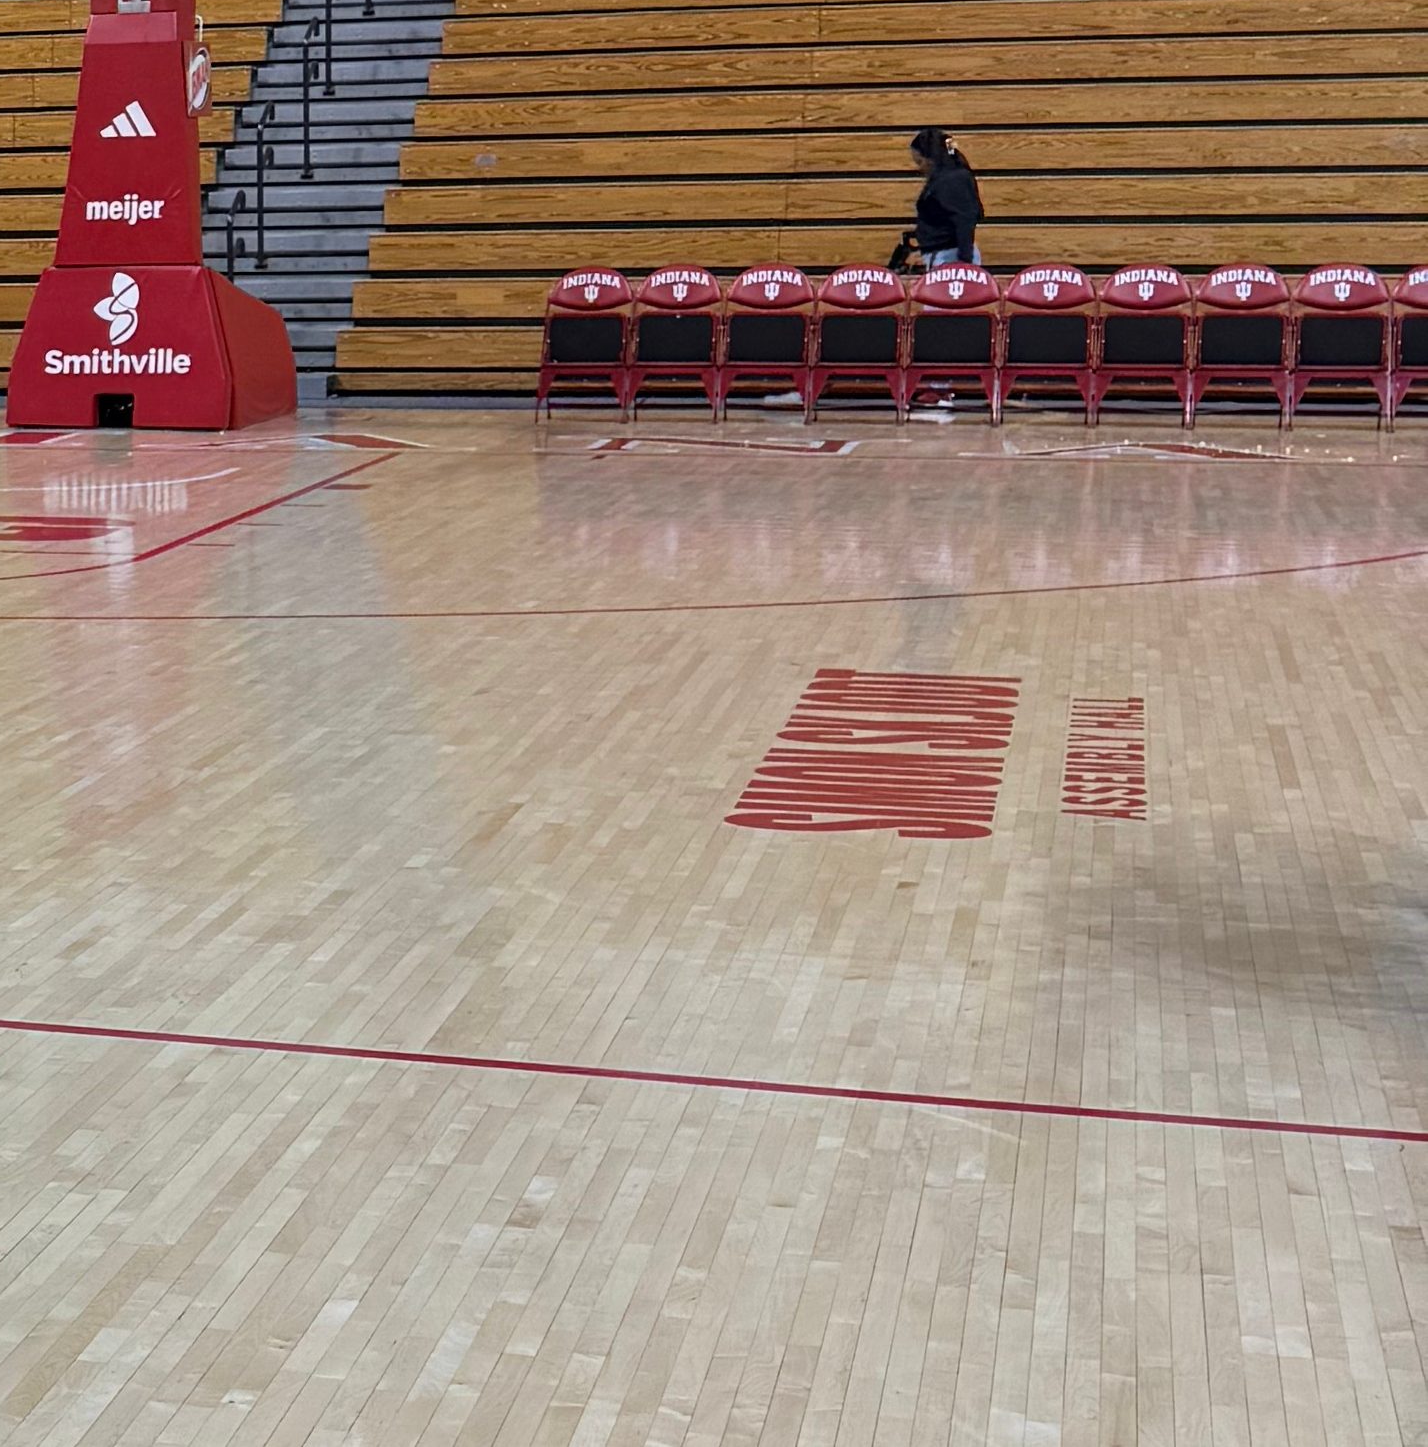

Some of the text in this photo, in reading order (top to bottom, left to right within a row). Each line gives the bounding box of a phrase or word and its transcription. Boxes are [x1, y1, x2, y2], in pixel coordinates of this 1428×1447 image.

[86, 193, 165, 226] meijer
[563, 272, 621, 289] INDIANA
[651, 270, 710, 288] INDIANA
[742, 269, 802, 286] INDIANA
[833, 269, 894, 286] INDIANA
[925, 268, 987, 285] INDIANA
[1020, 269, 1082, 286] INDIANA
[1114, 268, 1178, 286] INDIANA
[1211, 269, 1276, 286] INDIANA
[1310, 268, 1376, 286] INDIANA
[44, 348, 191, 375] Smithville
[724, 668, 1022, 840] SIMON SKJODT
[1061, 697, 1148, 821] ASSEMBLY HALL
